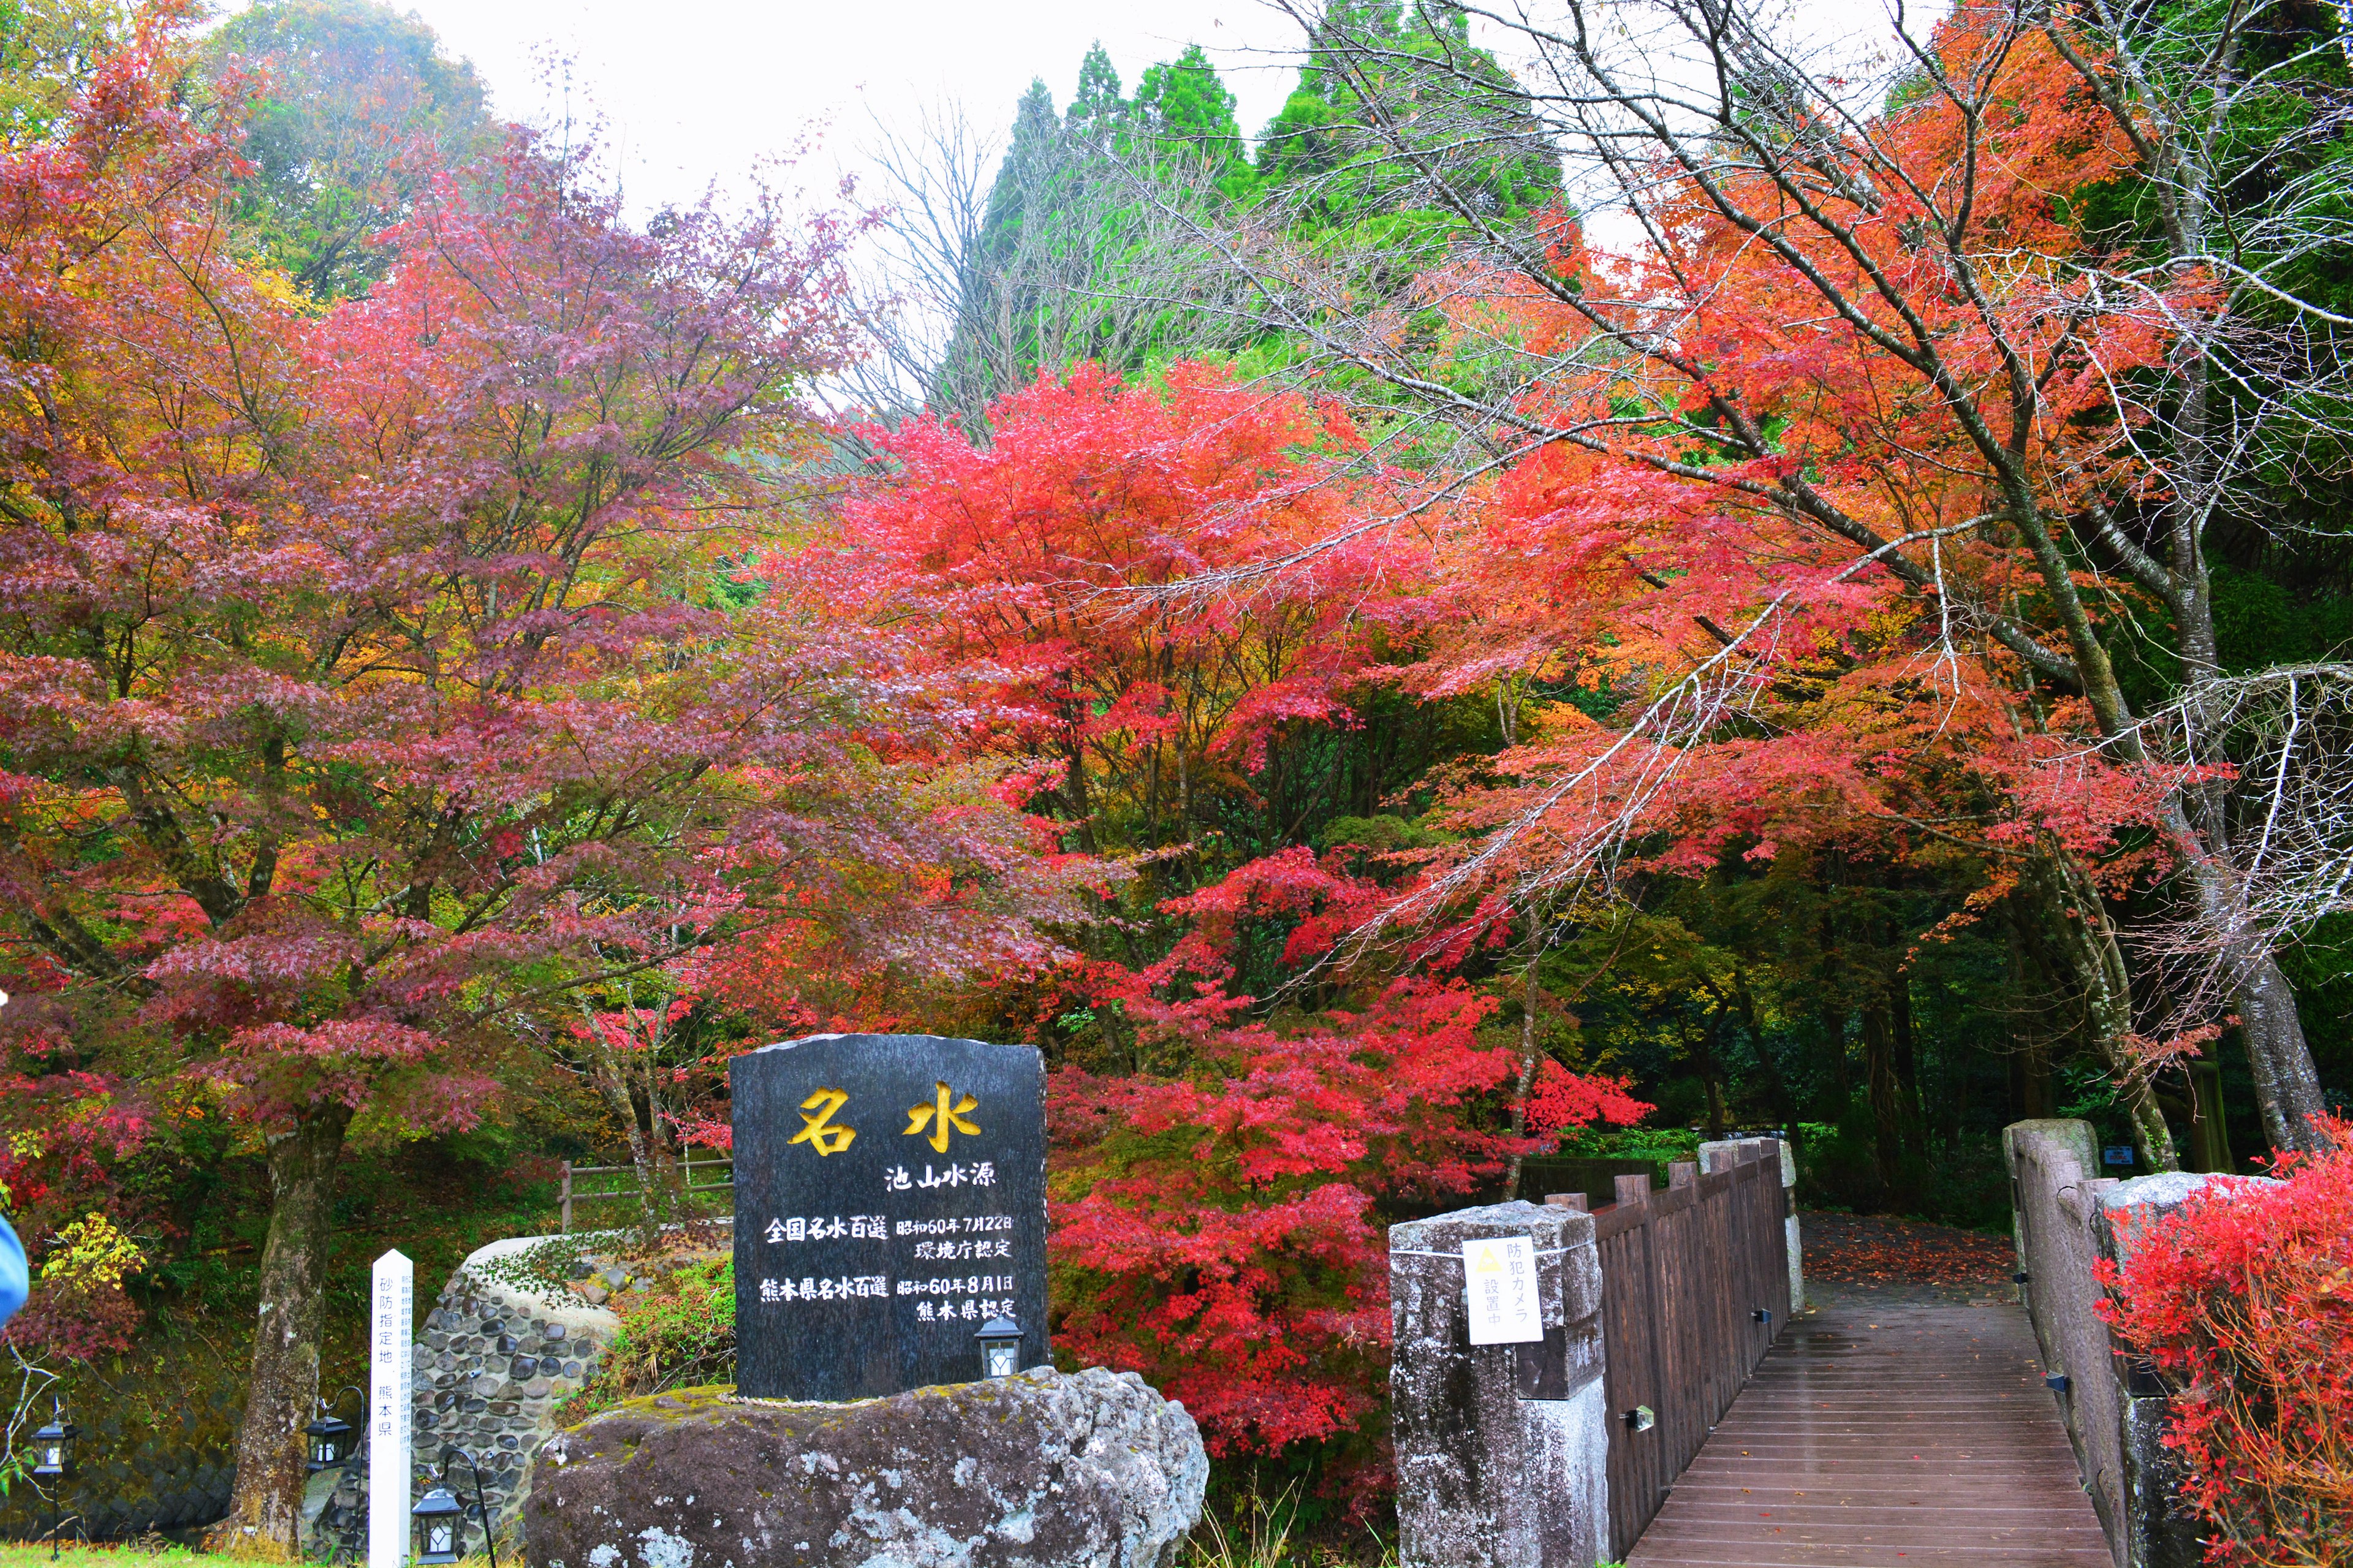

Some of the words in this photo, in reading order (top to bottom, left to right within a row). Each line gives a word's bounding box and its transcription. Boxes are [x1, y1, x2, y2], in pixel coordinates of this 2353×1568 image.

[884, 1162, 996, 1192] 池山水源
[764, 1215, 889, 1243] 全国名水百選
[914, 1239, 1012, 1260] 環境庁認定
[759, 1275, 889, 1302] 熊本県名水百選
[1506, 1243, 1528, 1323] 防犯カメラ
[916, 1298, 1017, 1322] 熊本県認定
[1483, 1279, 1501, 1328] 設置中
[379, 1277, 393, 1363] 砂防指定地
[379, 1385, 392, 1436] 熊本県
